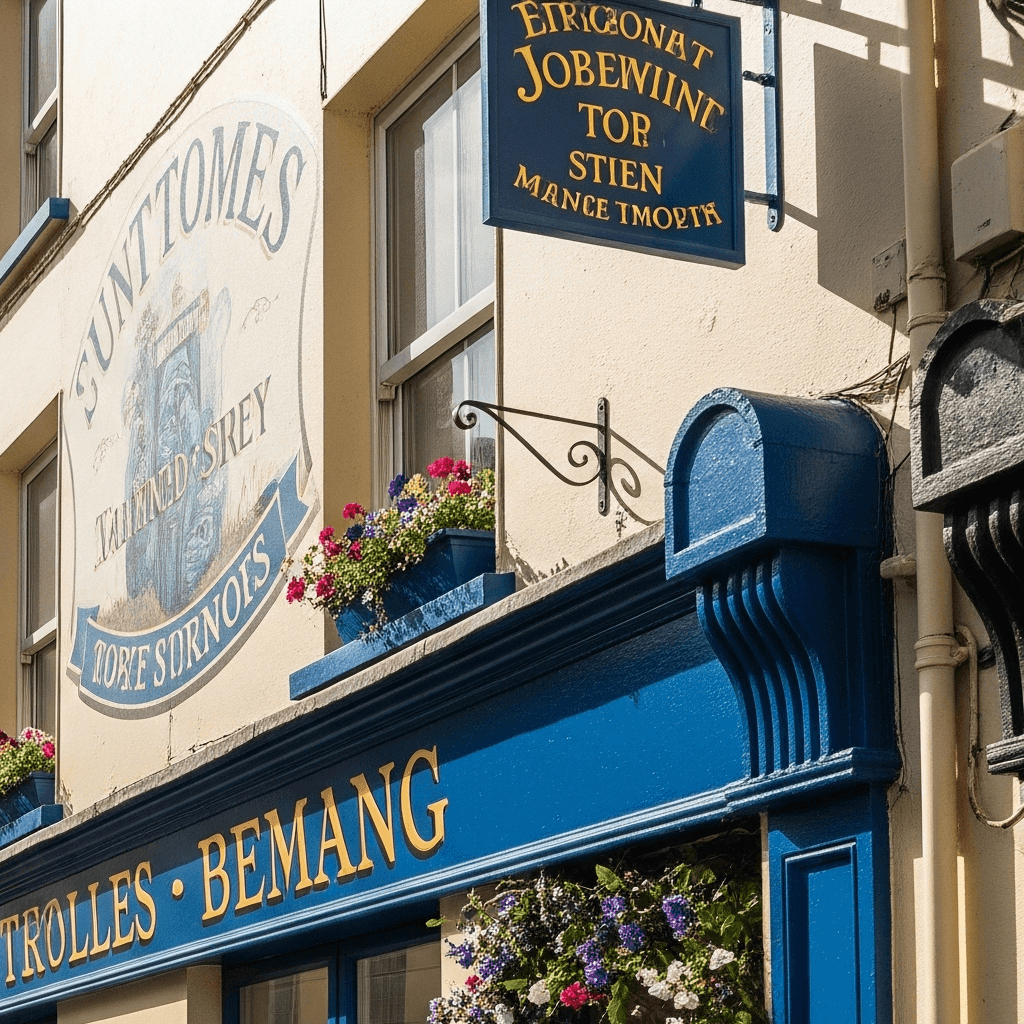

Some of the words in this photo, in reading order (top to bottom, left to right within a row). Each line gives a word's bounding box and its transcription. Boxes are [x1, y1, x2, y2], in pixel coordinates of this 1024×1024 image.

[568, 150, 664, 195] STIEN
[0, 860, 157, 984] TROLLES
[197, 744, 449, 923] BEMANG
